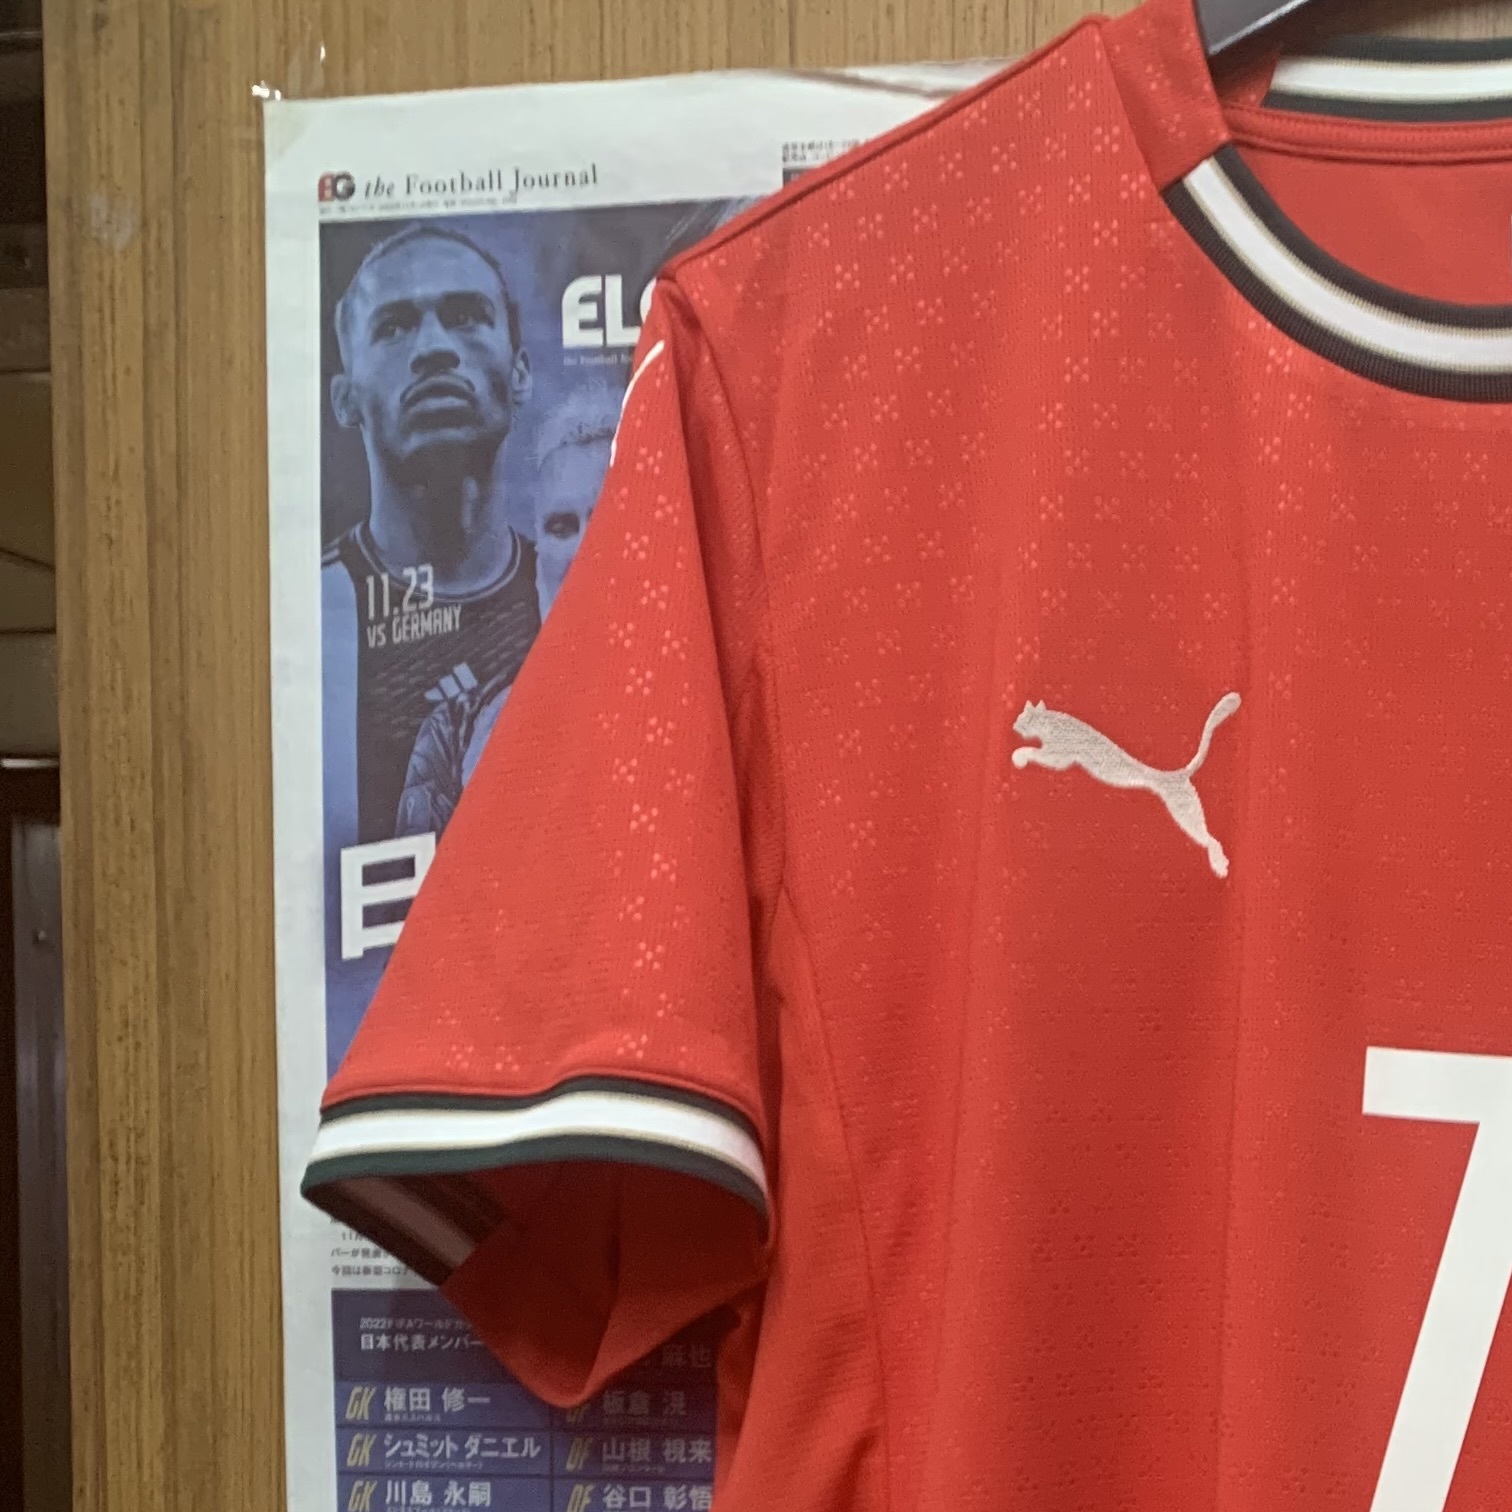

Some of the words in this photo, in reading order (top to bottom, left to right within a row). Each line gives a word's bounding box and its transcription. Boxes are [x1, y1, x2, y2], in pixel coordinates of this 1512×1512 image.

[365, 175, 394, 199] the
[406, 169, 501, 195] Football
[510, 163, 598, 192] Journal
[365, 565, 434, 618] 11.23
[367, 624, 386, 648] VS
[393, 604, 462, 643] GERMANY
[345, 1386, 376, 1420] GK
[384, 1387, 430, 1411] 権田
[442, 1387, 491, 1412] 修一
[347, 1433, 377, 1467] GK
[384, 1434, 458, 1459] シュミット
[464, 1434, 540, 1459] ダニエル
[602, 1437, 650, 1461] 山根
[386, 1480, 433, 1505] 川島
[603, 1484, 651, 1509] 谷口
